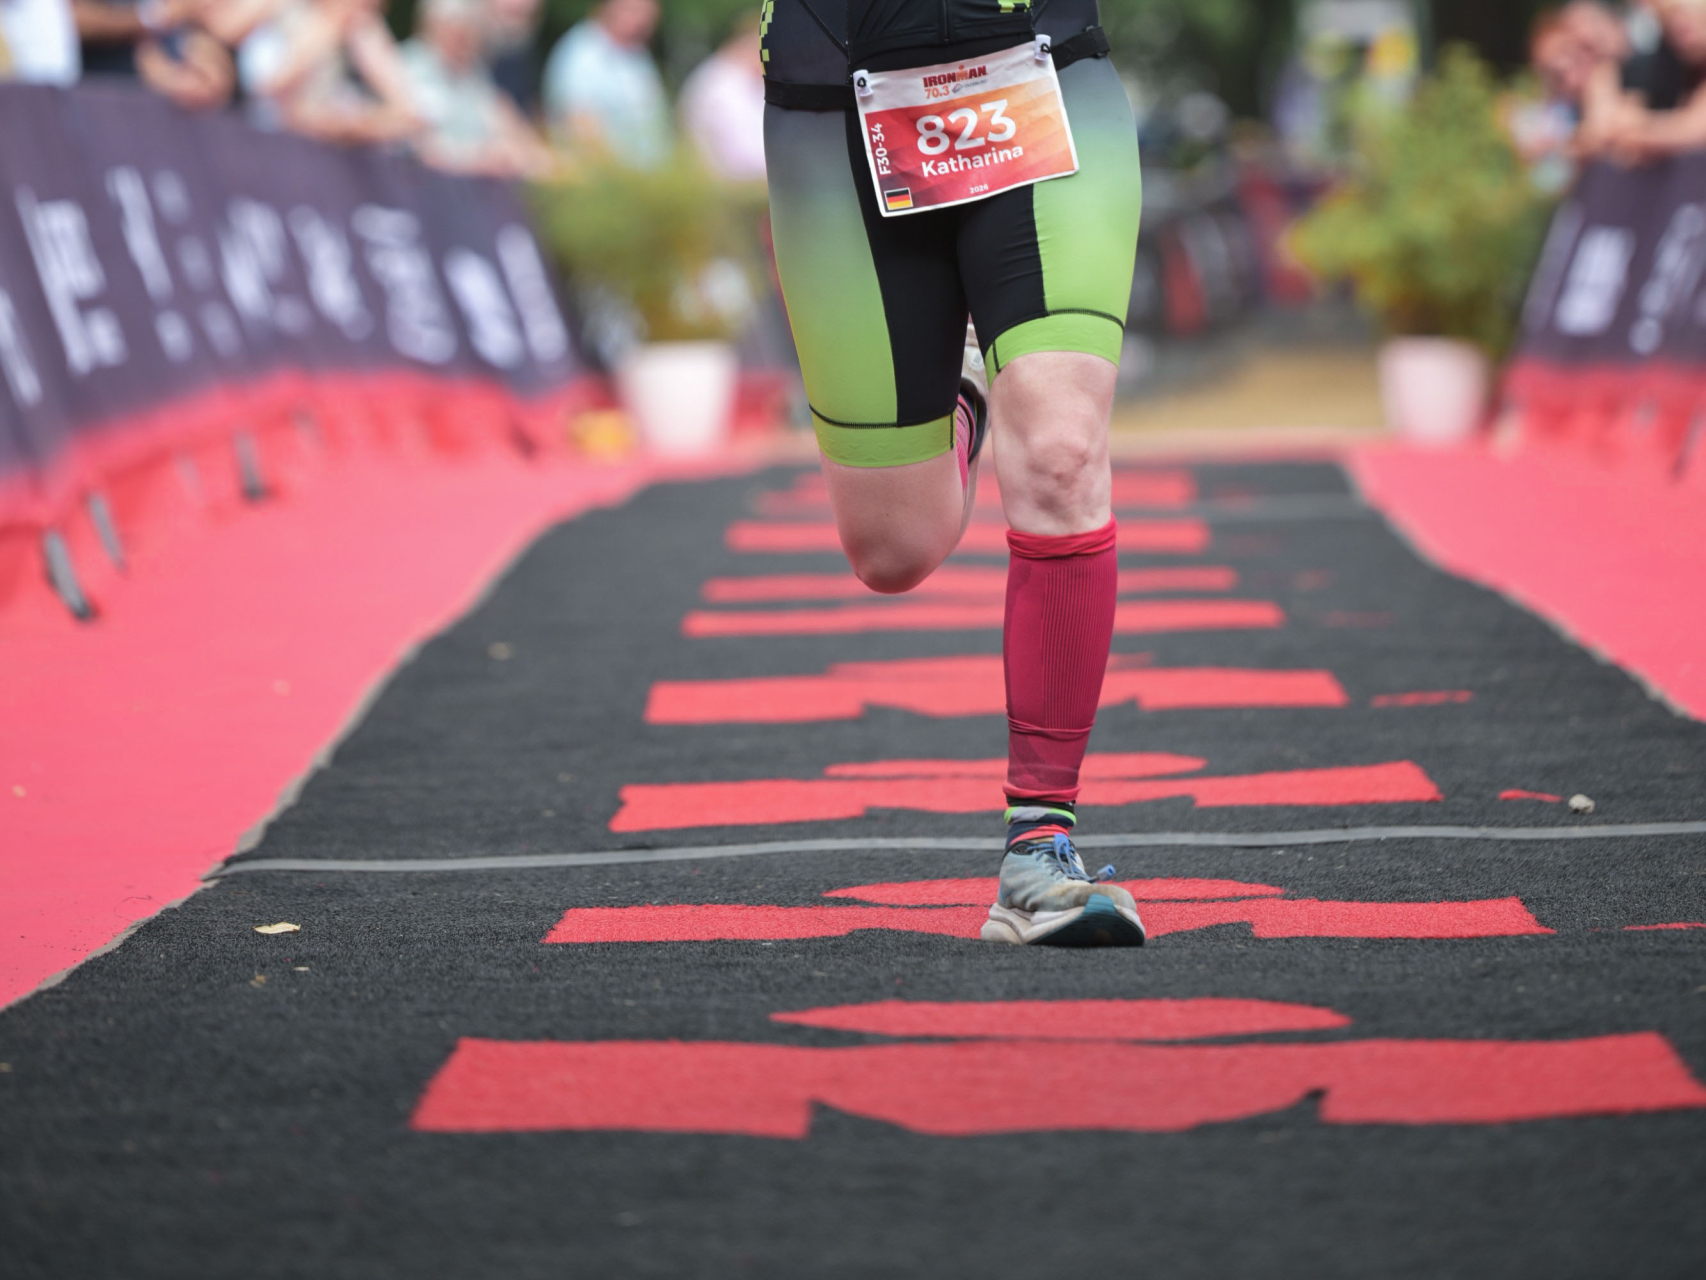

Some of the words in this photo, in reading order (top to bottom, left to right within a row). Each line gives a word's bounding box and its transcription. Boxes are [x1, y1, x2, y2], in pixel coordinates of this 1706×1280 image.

[923, 64, 988, 87] IRONMAN
[924, 84, 950, 99] 70.3
[916, 99, 1016, 155] 823
[870, 123, 892, 175] F30-34
[921, 146, 1023, 177] Katharina
